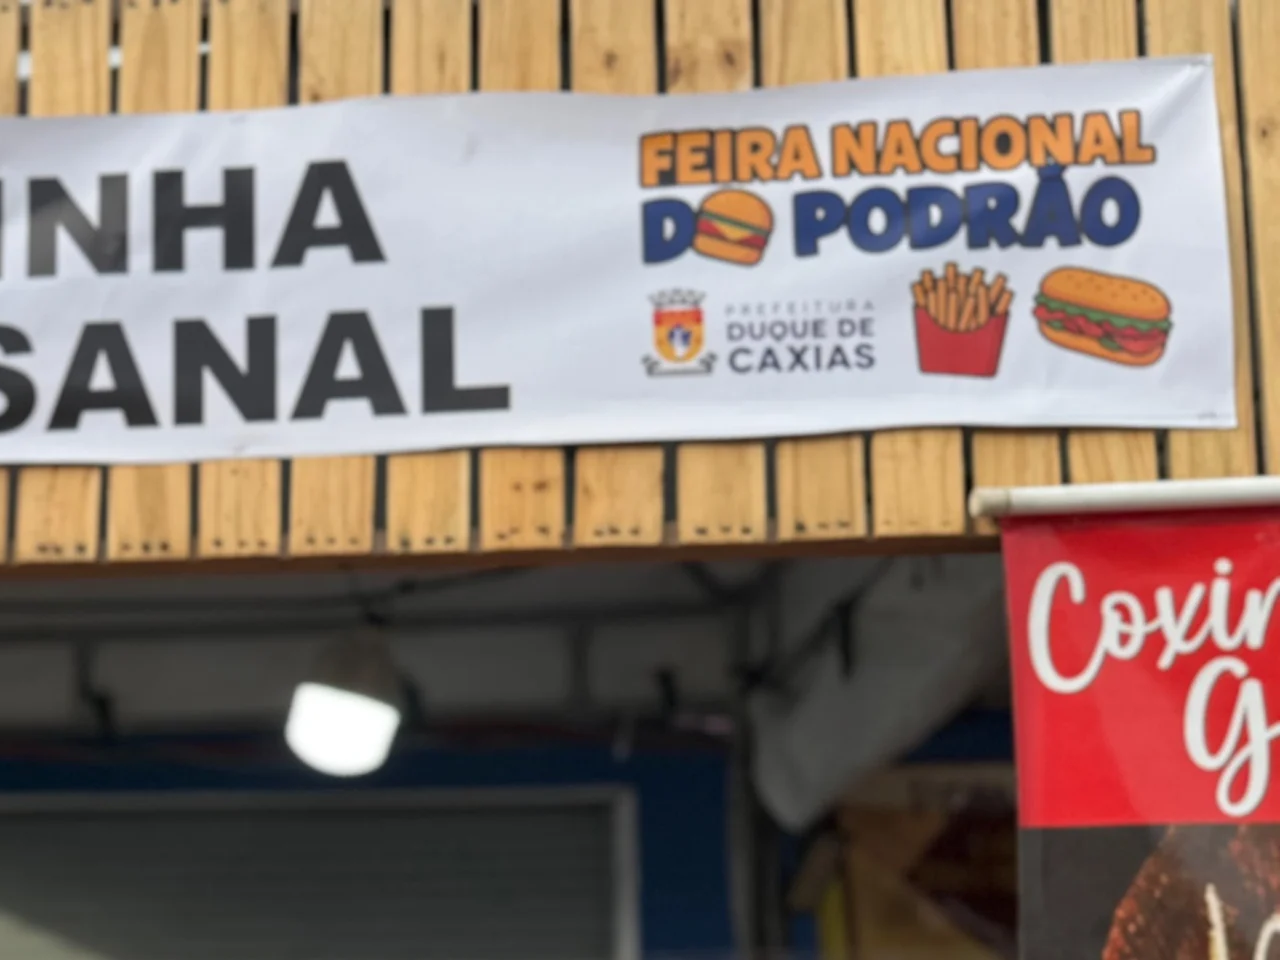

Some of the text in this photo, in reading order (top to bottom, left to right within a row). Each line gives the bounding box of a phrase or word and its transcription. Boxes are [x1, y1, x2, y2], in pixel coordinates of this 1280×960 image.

[640, 109, 1156, 188] FEIRA NACIONAL
[792, 164, 1141, 257] PODRÃO
[726, 317, 876, 342] DUQUE DE
[728, 344, 877, 375] CAXIAS
